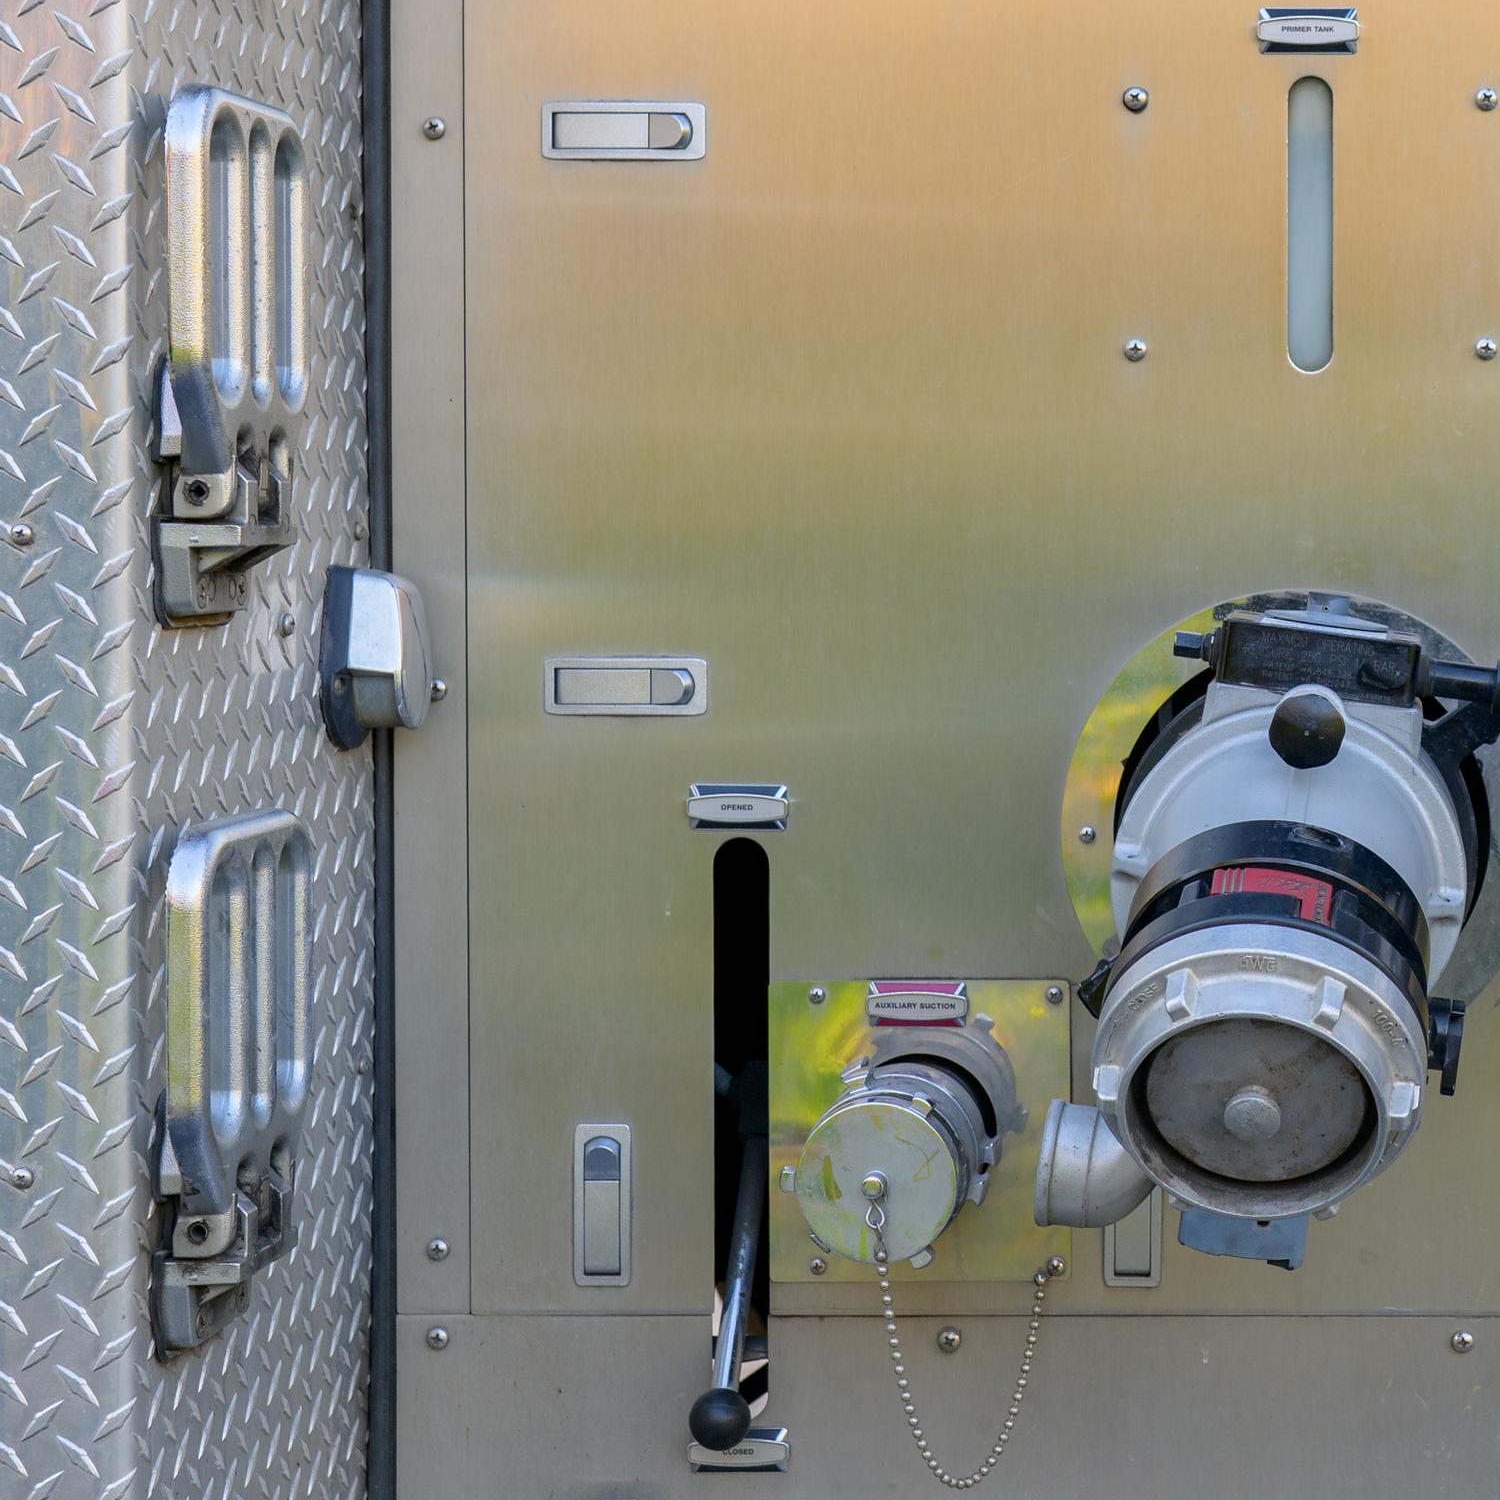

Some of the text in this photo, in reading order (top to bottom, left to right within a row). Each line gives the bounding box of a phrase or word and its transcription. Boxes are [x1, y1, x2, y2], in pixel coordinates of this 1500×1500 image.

[1259, 631, 1376, 658] MAXIMUM OPERATING
[1239, 955, 1278, 972] AWG
